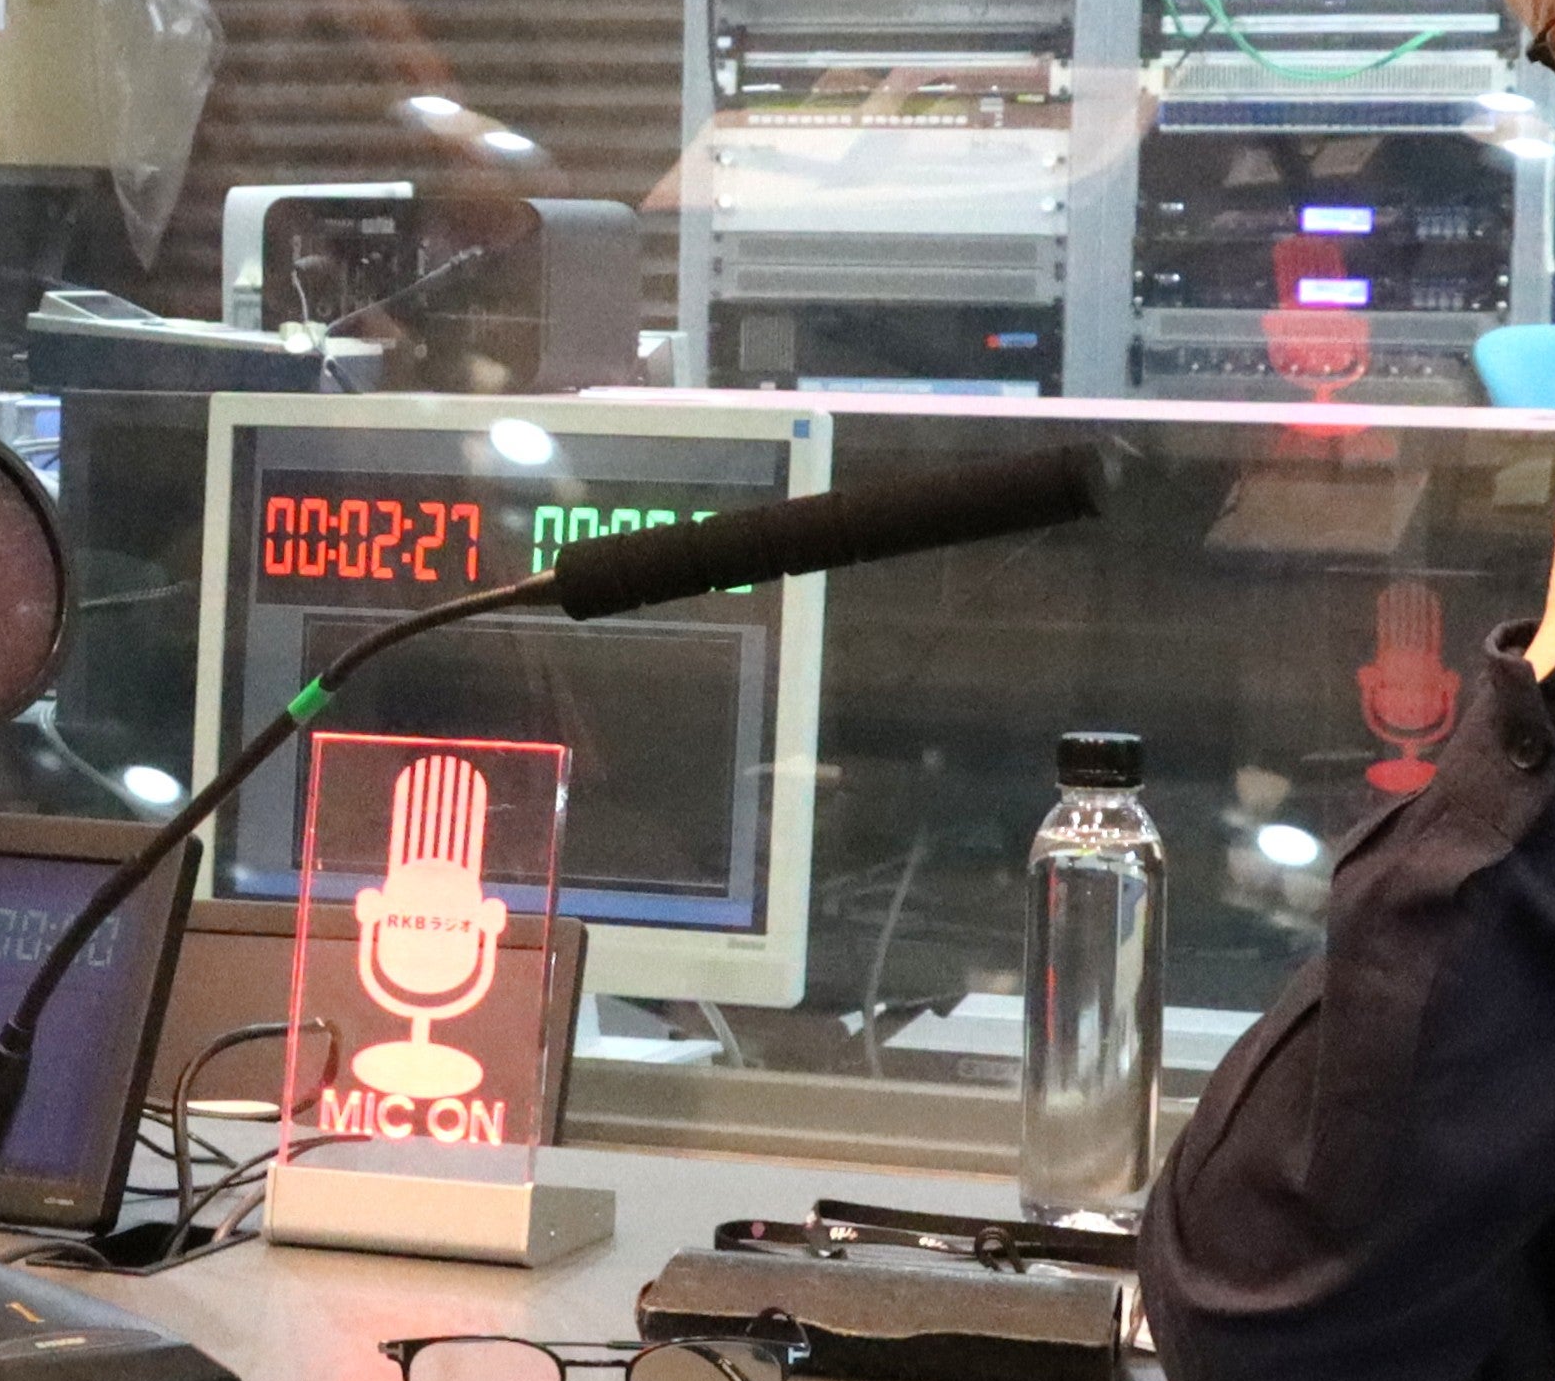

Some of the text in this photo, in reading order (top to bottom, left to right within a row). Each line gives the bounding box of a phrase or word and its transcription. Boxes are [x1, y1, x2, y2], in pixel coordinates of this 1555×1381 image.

[263, 496, 481, 581] 00:02:27
[387, 913, 473, 934] RKBラジオ
[319, 1087, 506, 1146] MIC ON
